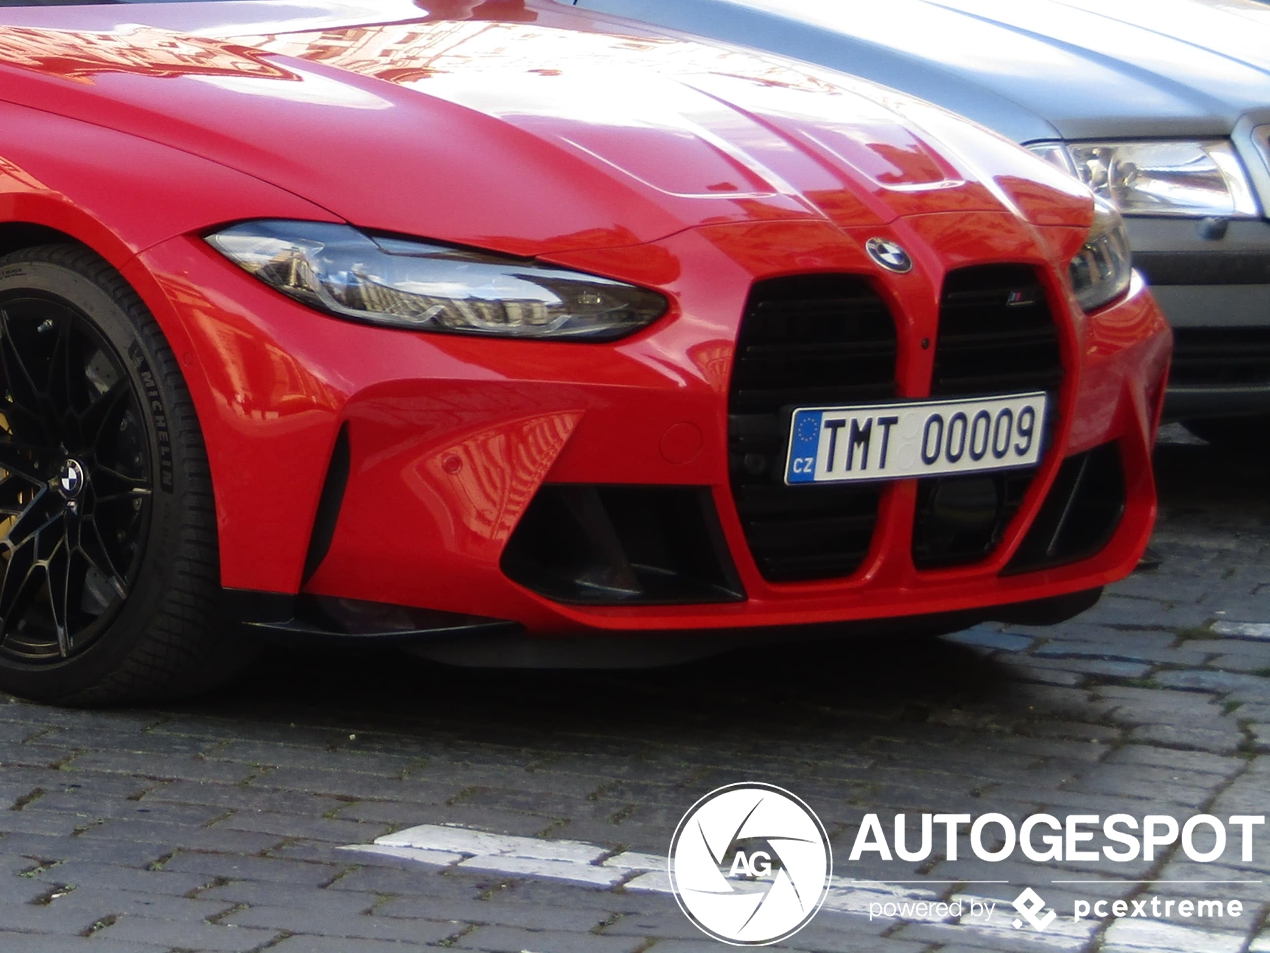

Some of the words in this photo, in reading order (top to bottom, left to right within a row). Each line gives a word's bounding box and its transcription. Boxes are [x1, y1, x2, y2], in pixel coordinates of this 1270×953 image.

[141, 370, 173, 486] MICHELIN
[824, 416, 899, 473] TMT
[921, 405, 1036, 466] 00009
[793, 456, 814, 474] CZ
